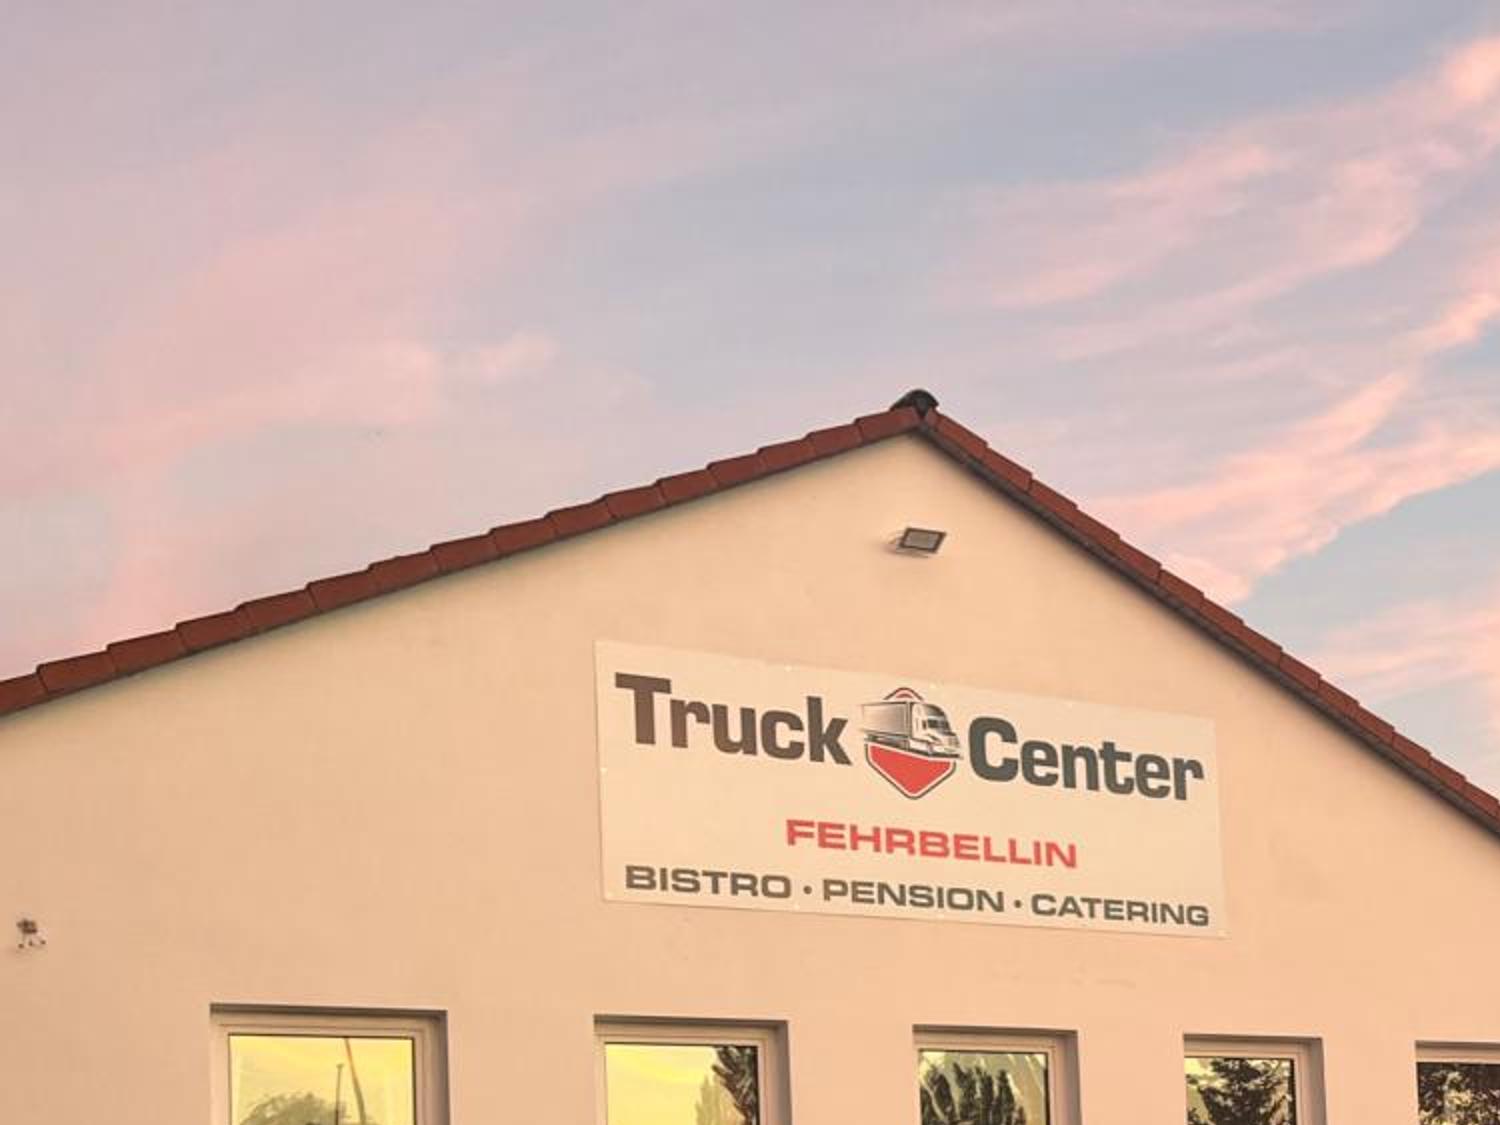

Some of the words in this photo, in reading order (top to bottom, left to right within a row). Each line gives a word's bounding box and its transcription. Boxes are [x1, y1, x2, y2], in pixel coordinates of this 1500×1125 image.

[614, 671, 853, 766] Truck
[968, 716, 1205, 801] Center
[785, 818, 1077, 869] FEHRBELLIN
[625, 865, 792, 899] BISTRO
[822, 878, 1005, 913] PENSION
[1031, 893, 1210, 927] CATERING
